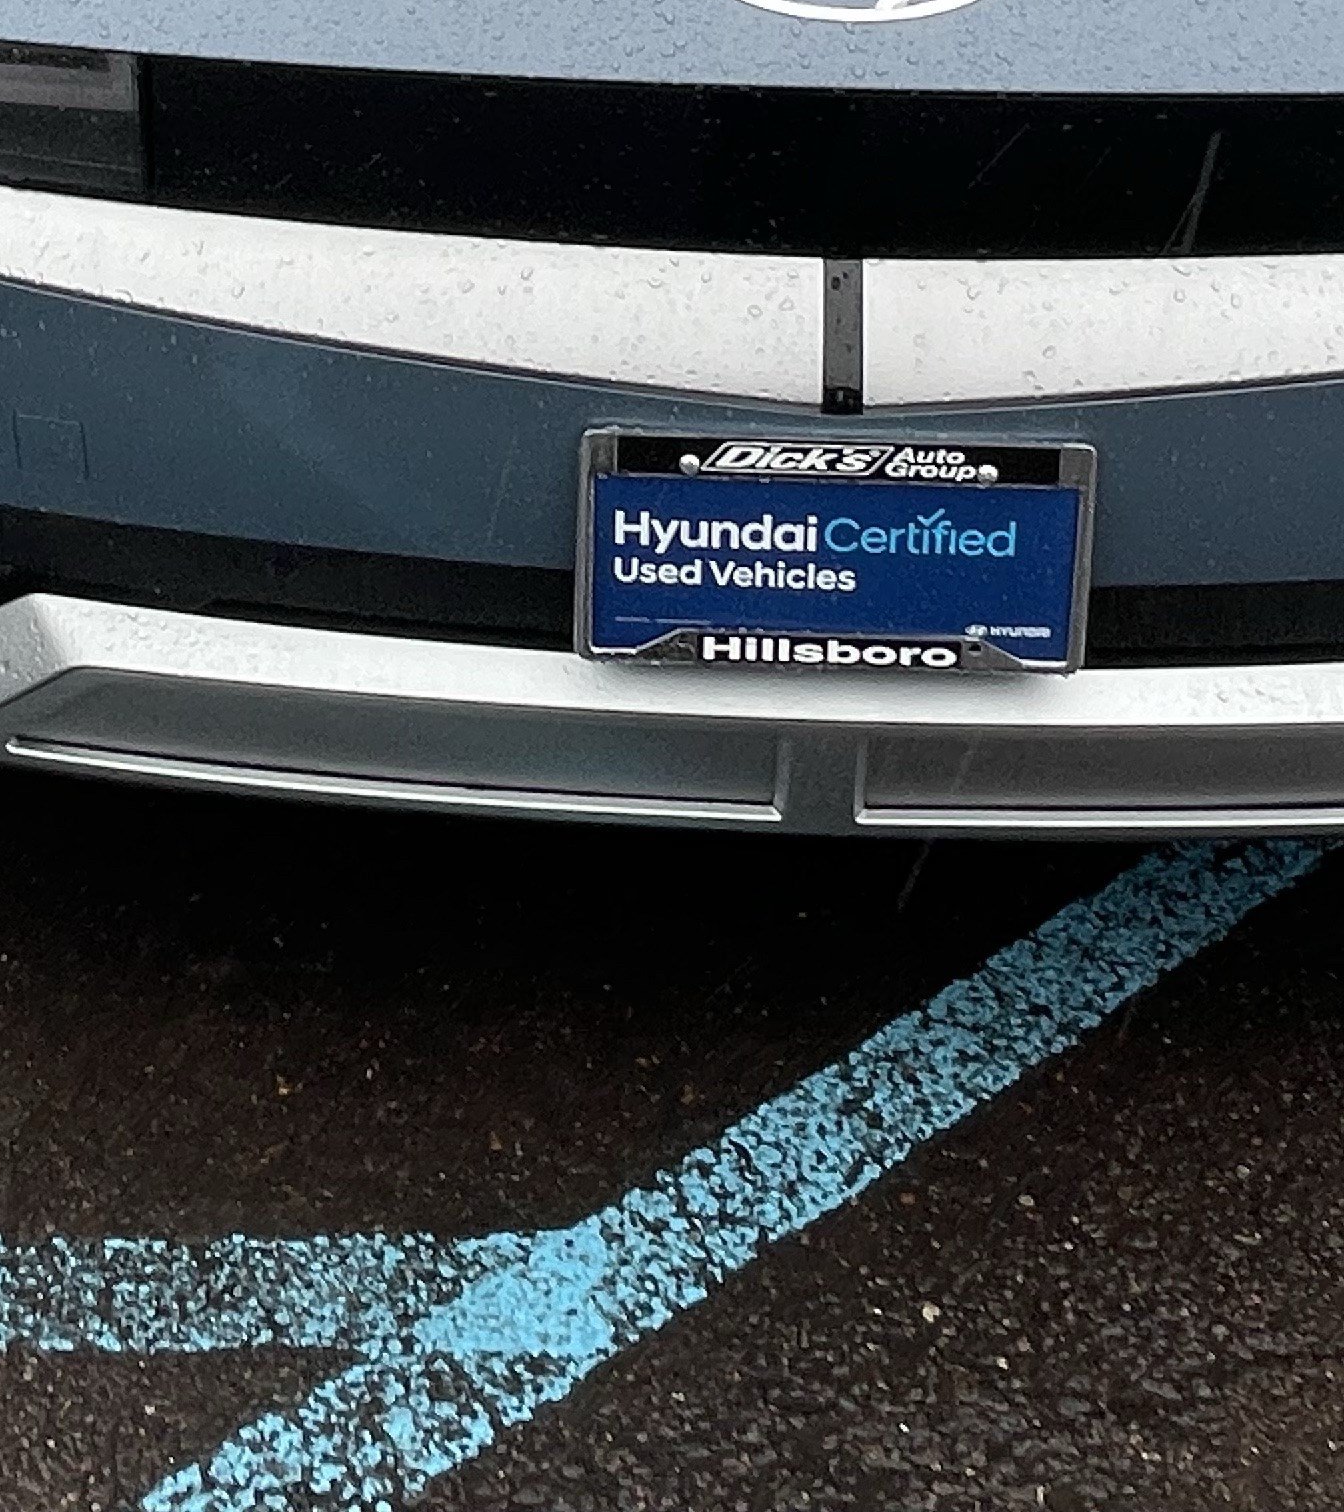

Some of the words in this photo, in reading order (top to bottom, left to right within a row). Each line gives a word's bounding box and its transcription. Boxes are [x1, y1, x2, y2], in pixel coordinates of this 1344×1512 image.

[891, 446, 965, 464] Auto
[884, 462, 977, 482] Group
[613, 509, 818, 554] Hyundai
[823, 508, 1017, 557] Certified
[613, 557, 703, 587] Used
[709, 561, 856, 591] Vehicles
[702, 636, 957, 667] Hillsboro
